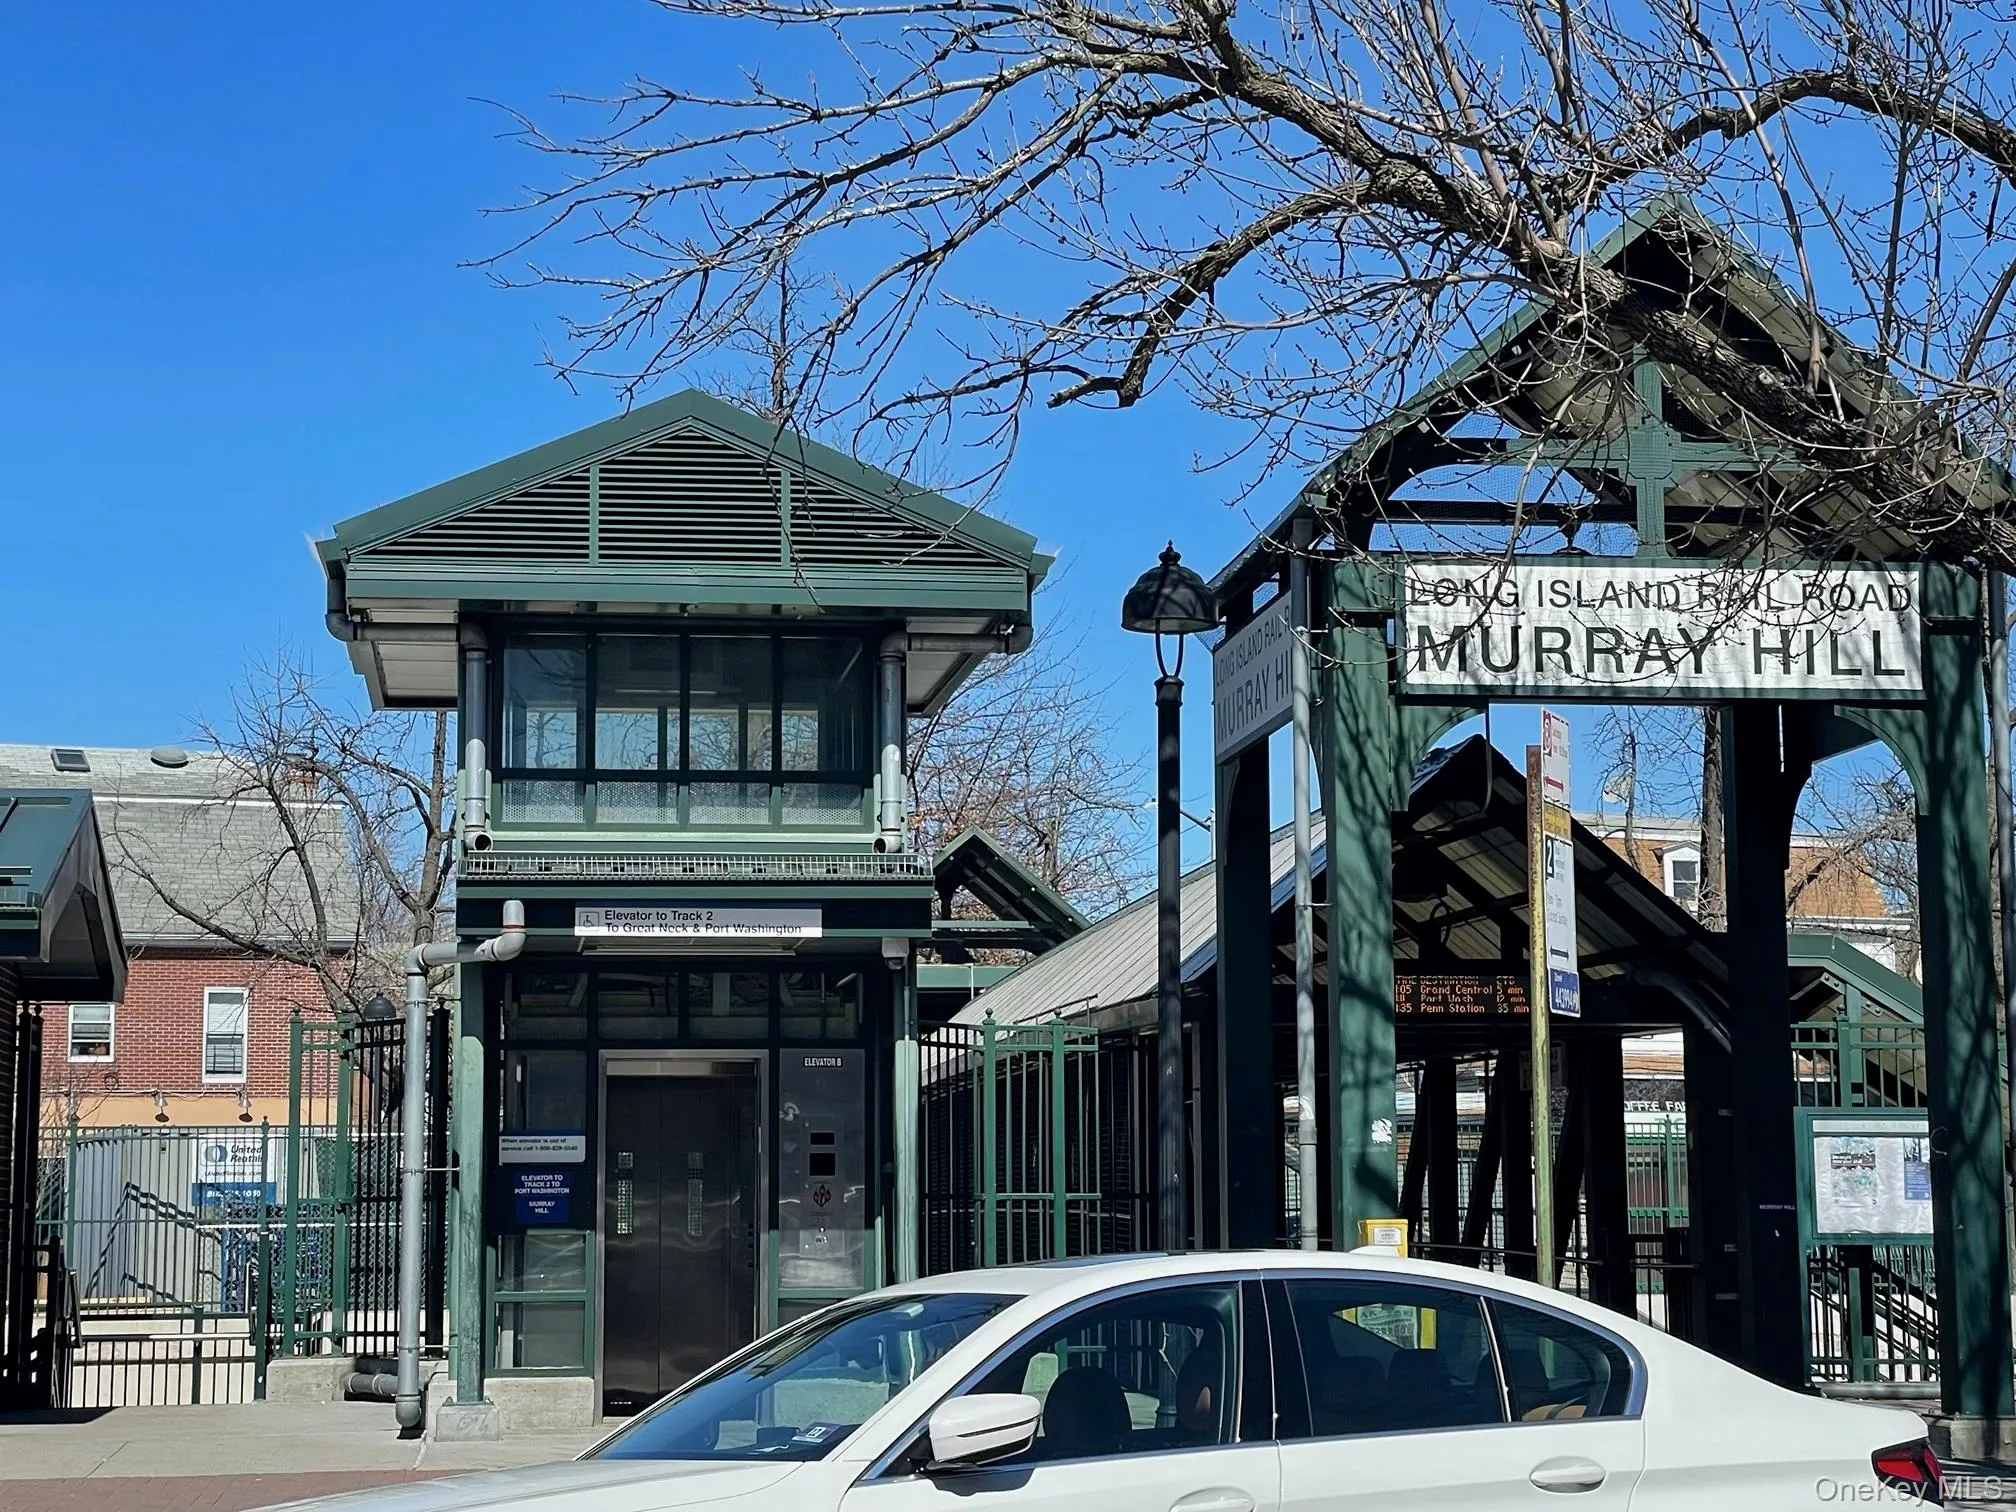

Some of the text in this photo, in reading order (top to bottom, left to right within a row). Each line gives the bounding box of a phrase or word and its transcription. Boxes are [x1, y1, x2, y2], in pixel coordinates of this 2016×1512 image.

[1410, 578, 1912, 612] LONG ISLAND RAIL ROAD
[1215, 651, 1235, 688] LONG
[1236, 627, 1263, 671] ISLAND
[1265, 613, 1282, 647] RAIL
[1417, 625, 1905, 676] MURRAY HILL
[1217, 664, 1270, 743] MURRAY
[605, 910, 713, 921] Elevator to Track 2
[605, 923, 802, 936] To Great Neck & Port Washington
[1420, 984, 1451, 994] Grand
[1455, 984, 1493, 994] Central
[1496, 985, 1503, 994] 5
[1507, 985, 1523, 994] min
[1420, 1003, 1444, 1013] Penn
[1449, 1003, 1485, 1013] Station
[1497, 1003, 1509, 1013] 35
[1514, 1004, 1530, 1013] min
[804, 1058, 836, 1067] ELEVATOR
